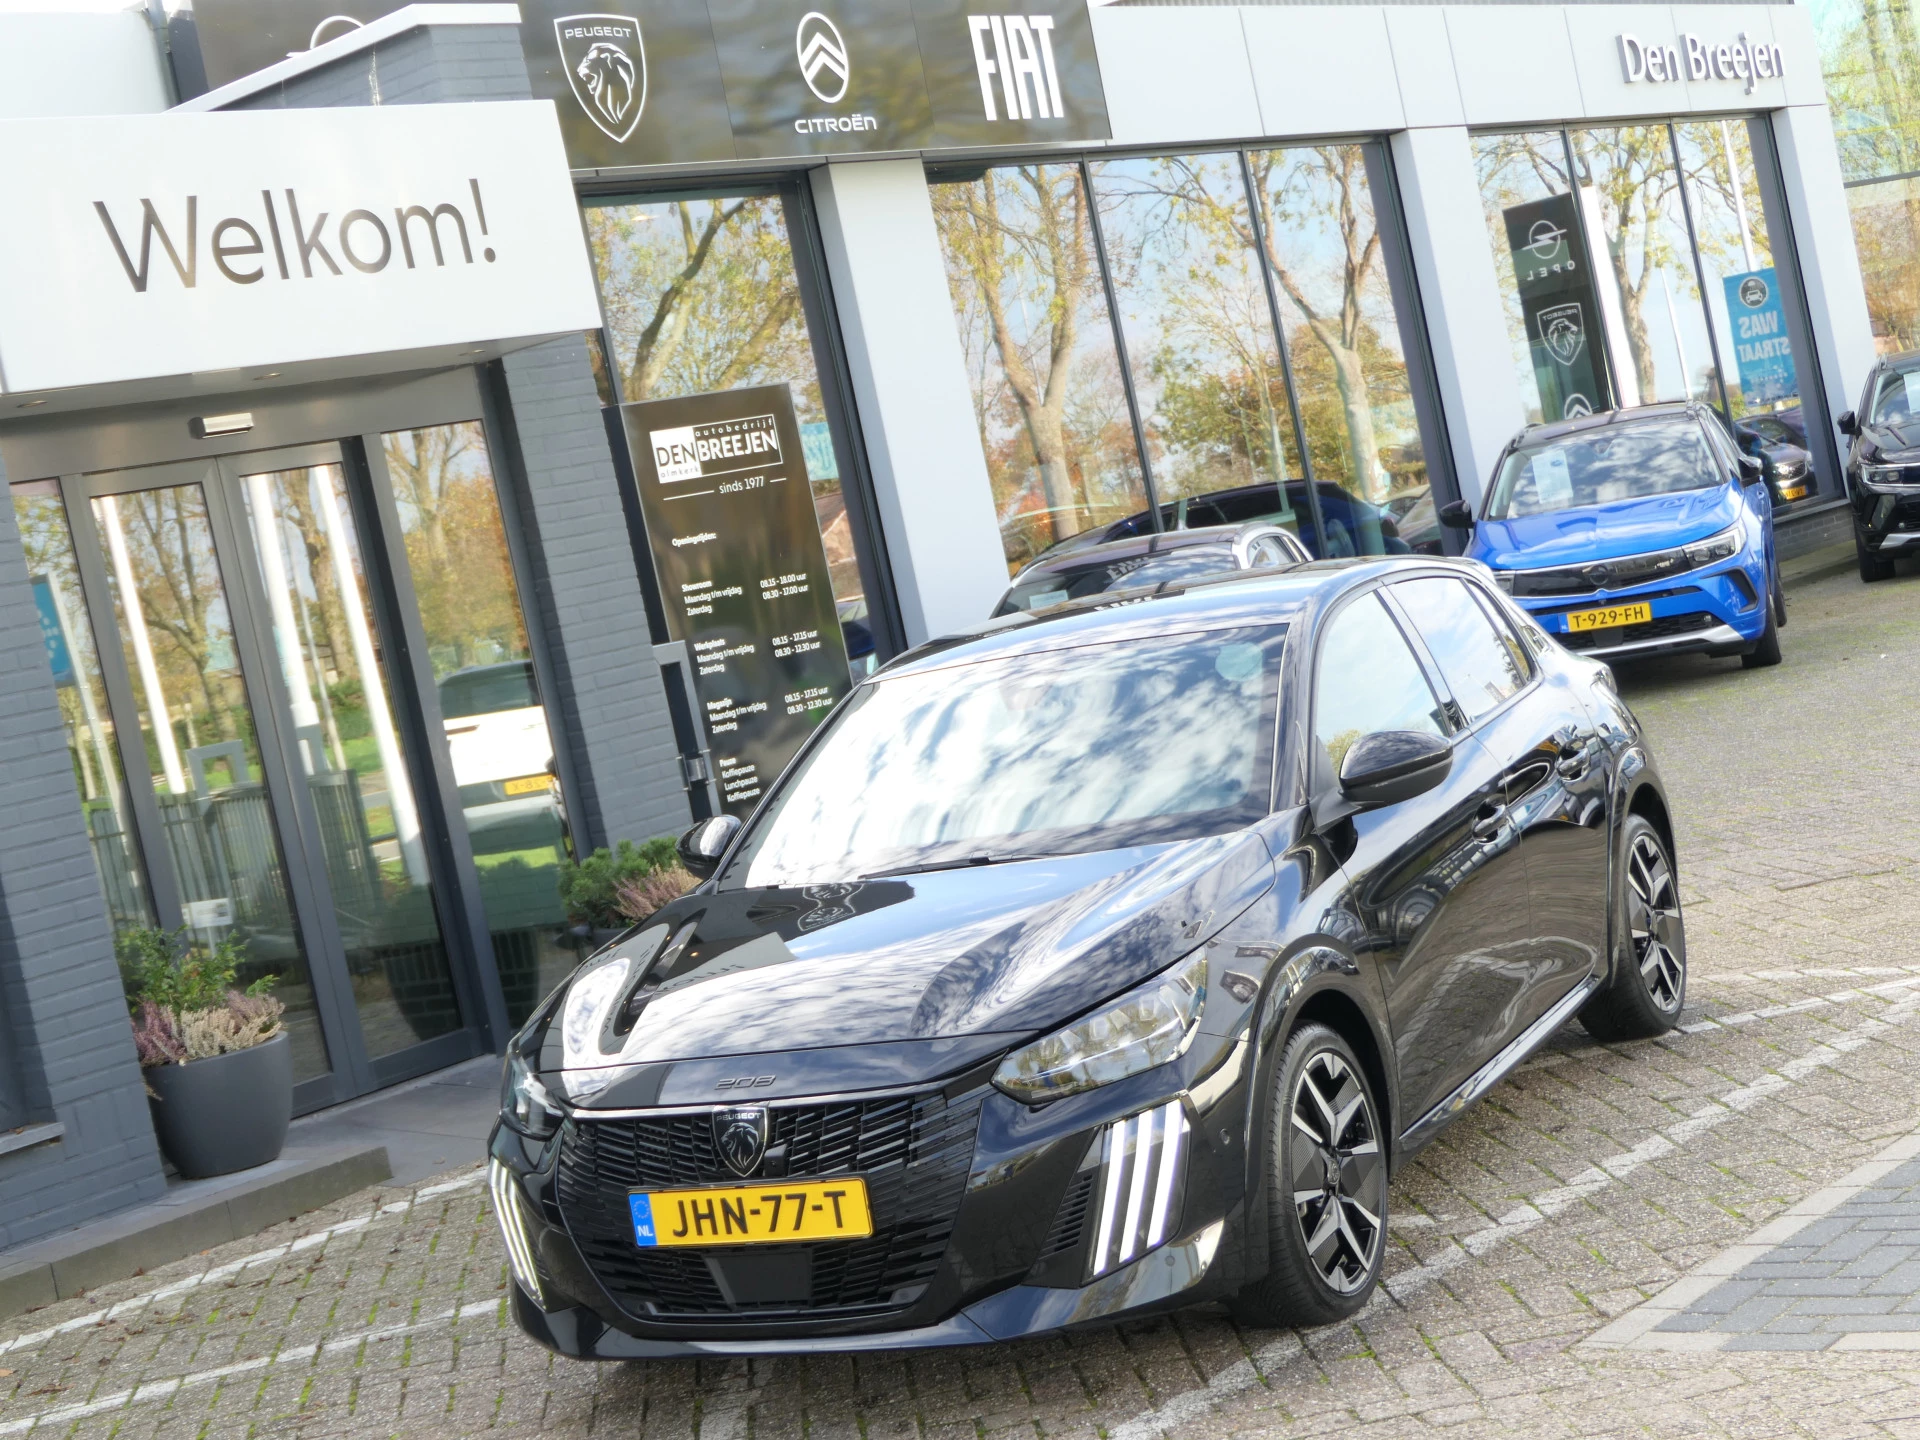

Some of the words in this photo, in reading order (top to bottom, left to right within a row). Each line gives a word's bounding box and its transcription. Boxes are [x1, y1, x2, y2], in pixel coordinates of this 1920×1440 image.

[564, 26, 631, 39] PEUGEOT
[967, 15, 1065, 120] FIAT
[1615, 33, 1682, 83] Den
[1679, 31, 1786, 95] Breejen
[92, 178, 497, 293] Welkom!
[695, 418, 773, 437] autobedrijf
[719, 482, 743, 494] sinds
[744, 476, 765, 490] 1977
[1572, 605, 1645, 629] T-929-FH
[714, 1074, 776, 1090] 208
[716, 1112, 762, 1122] PEUGEOT
[672, 1190, 847, 1238] JHN-77-T
[637, 1225, 653, 1237] NL
